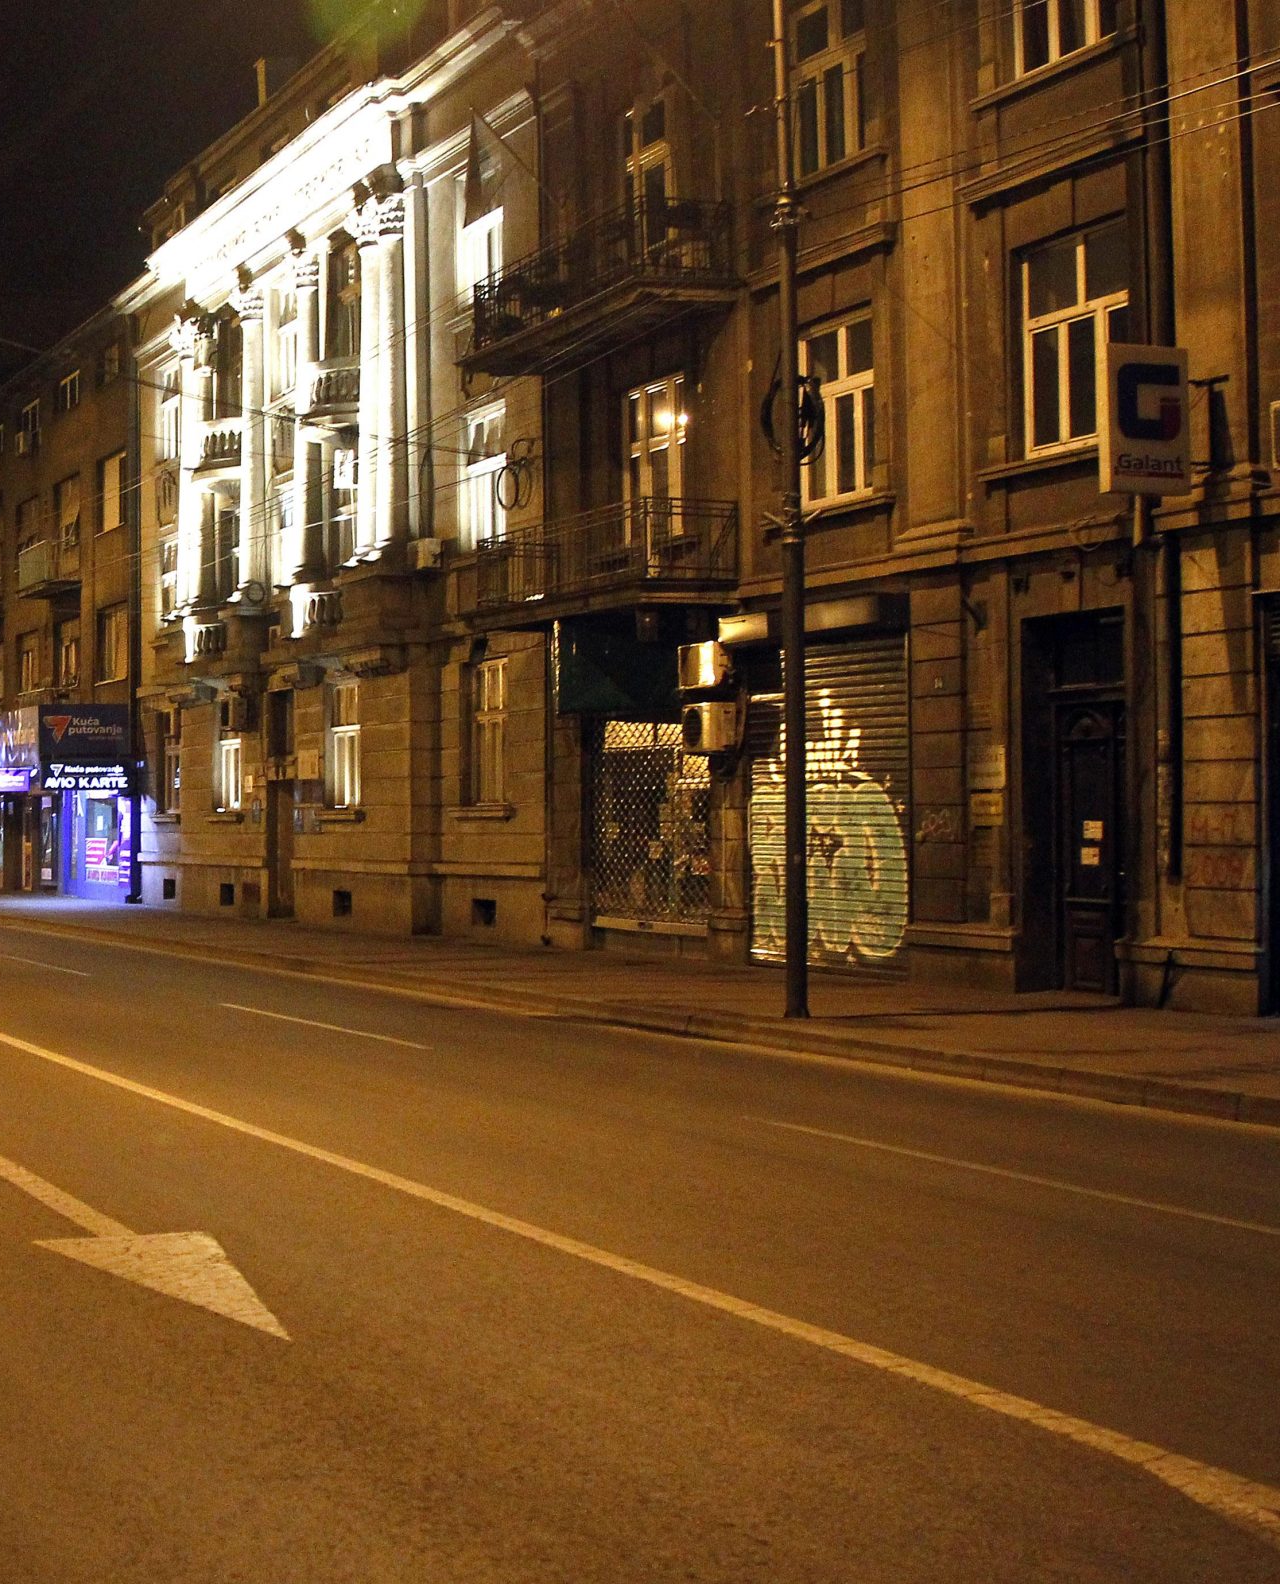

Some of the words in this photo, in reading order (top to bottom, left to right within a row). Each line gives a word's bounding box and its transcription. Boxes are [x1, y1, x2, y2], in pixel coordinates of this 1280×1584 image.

[1117, 454, 1182, 472] Galant
[72, 717, 100, 726] Kuća
[68, 724, 123, 736] putovanja
[45, 777, 76, 788] AVIO
[78, 777, 128, 789] KARTE
